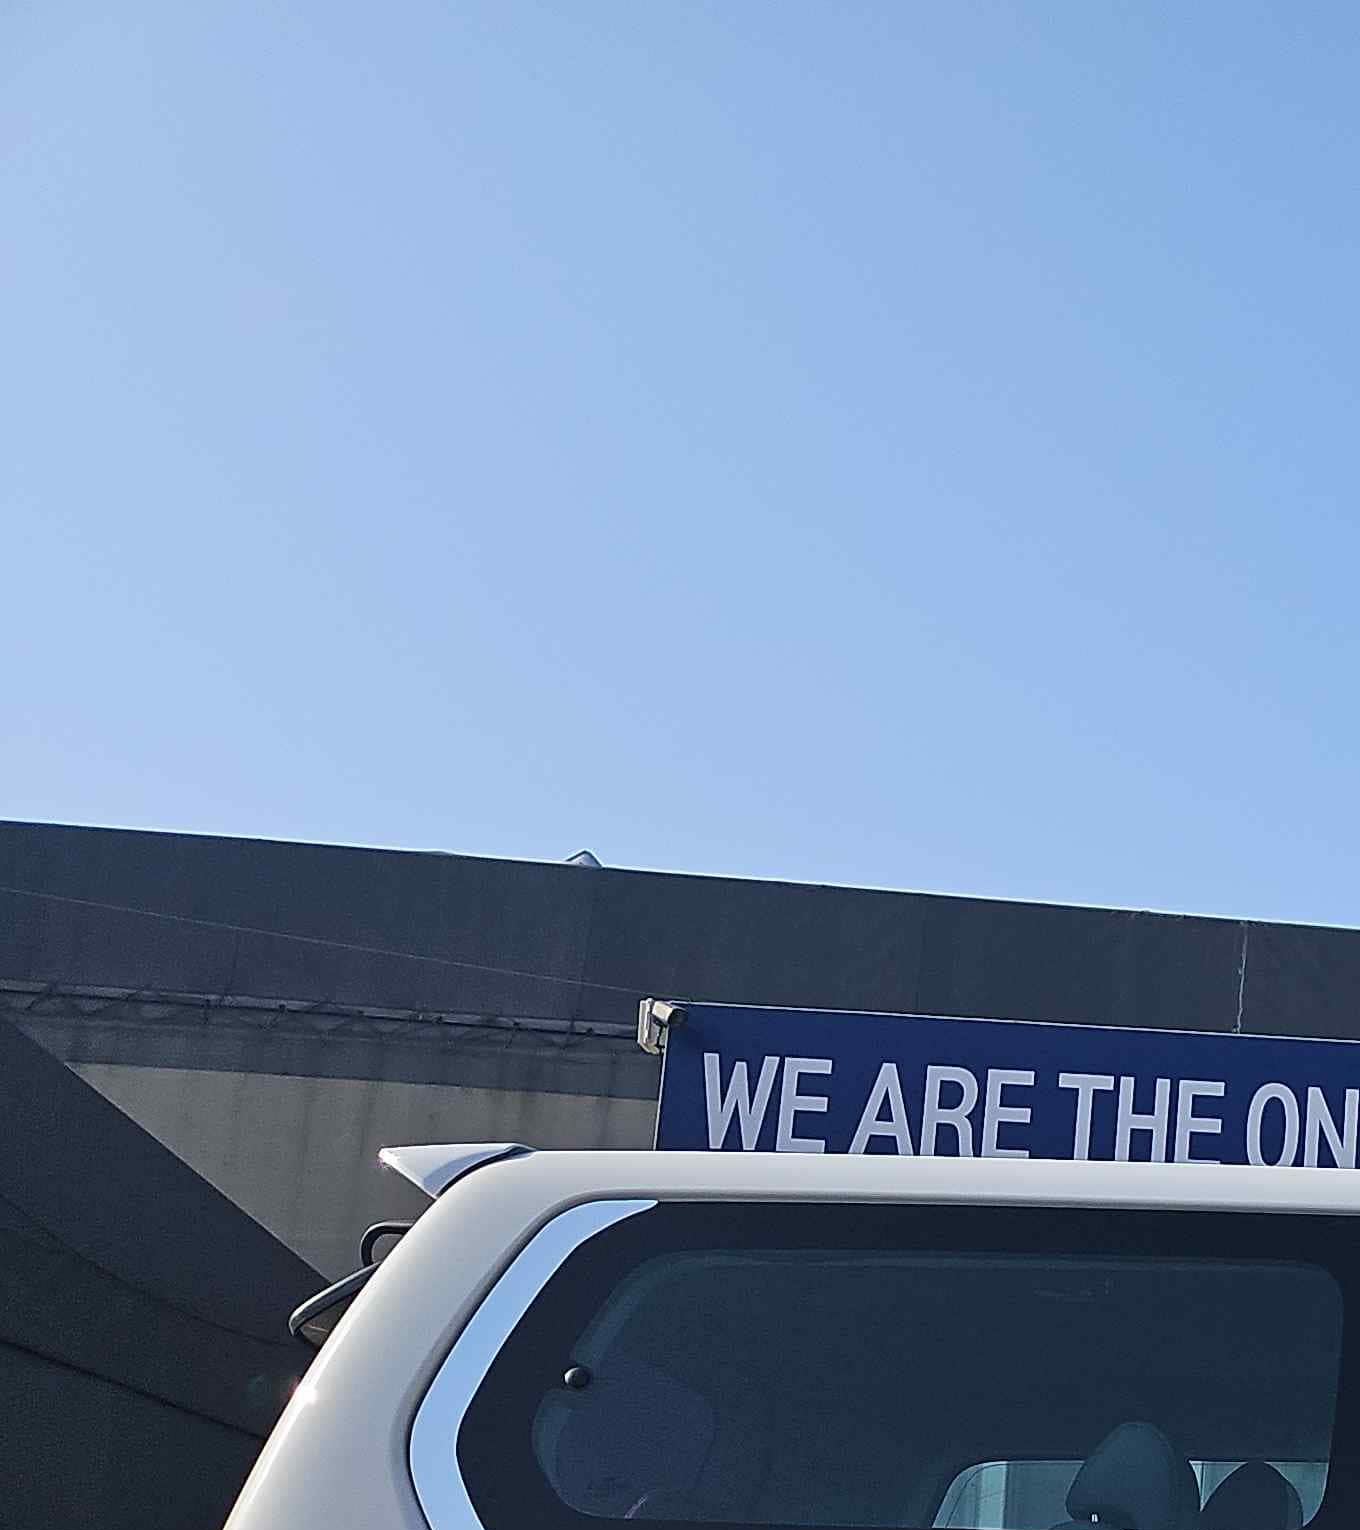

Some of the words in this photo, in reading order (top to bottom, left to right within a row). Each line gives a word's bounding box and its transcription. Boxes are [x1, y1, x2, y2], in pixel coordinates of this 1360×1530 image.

[703, 1052, 832, 1152] WE
[847, 1061, 1036, 1158] ARE
[1058, 1072, 1225, 1165] THE
